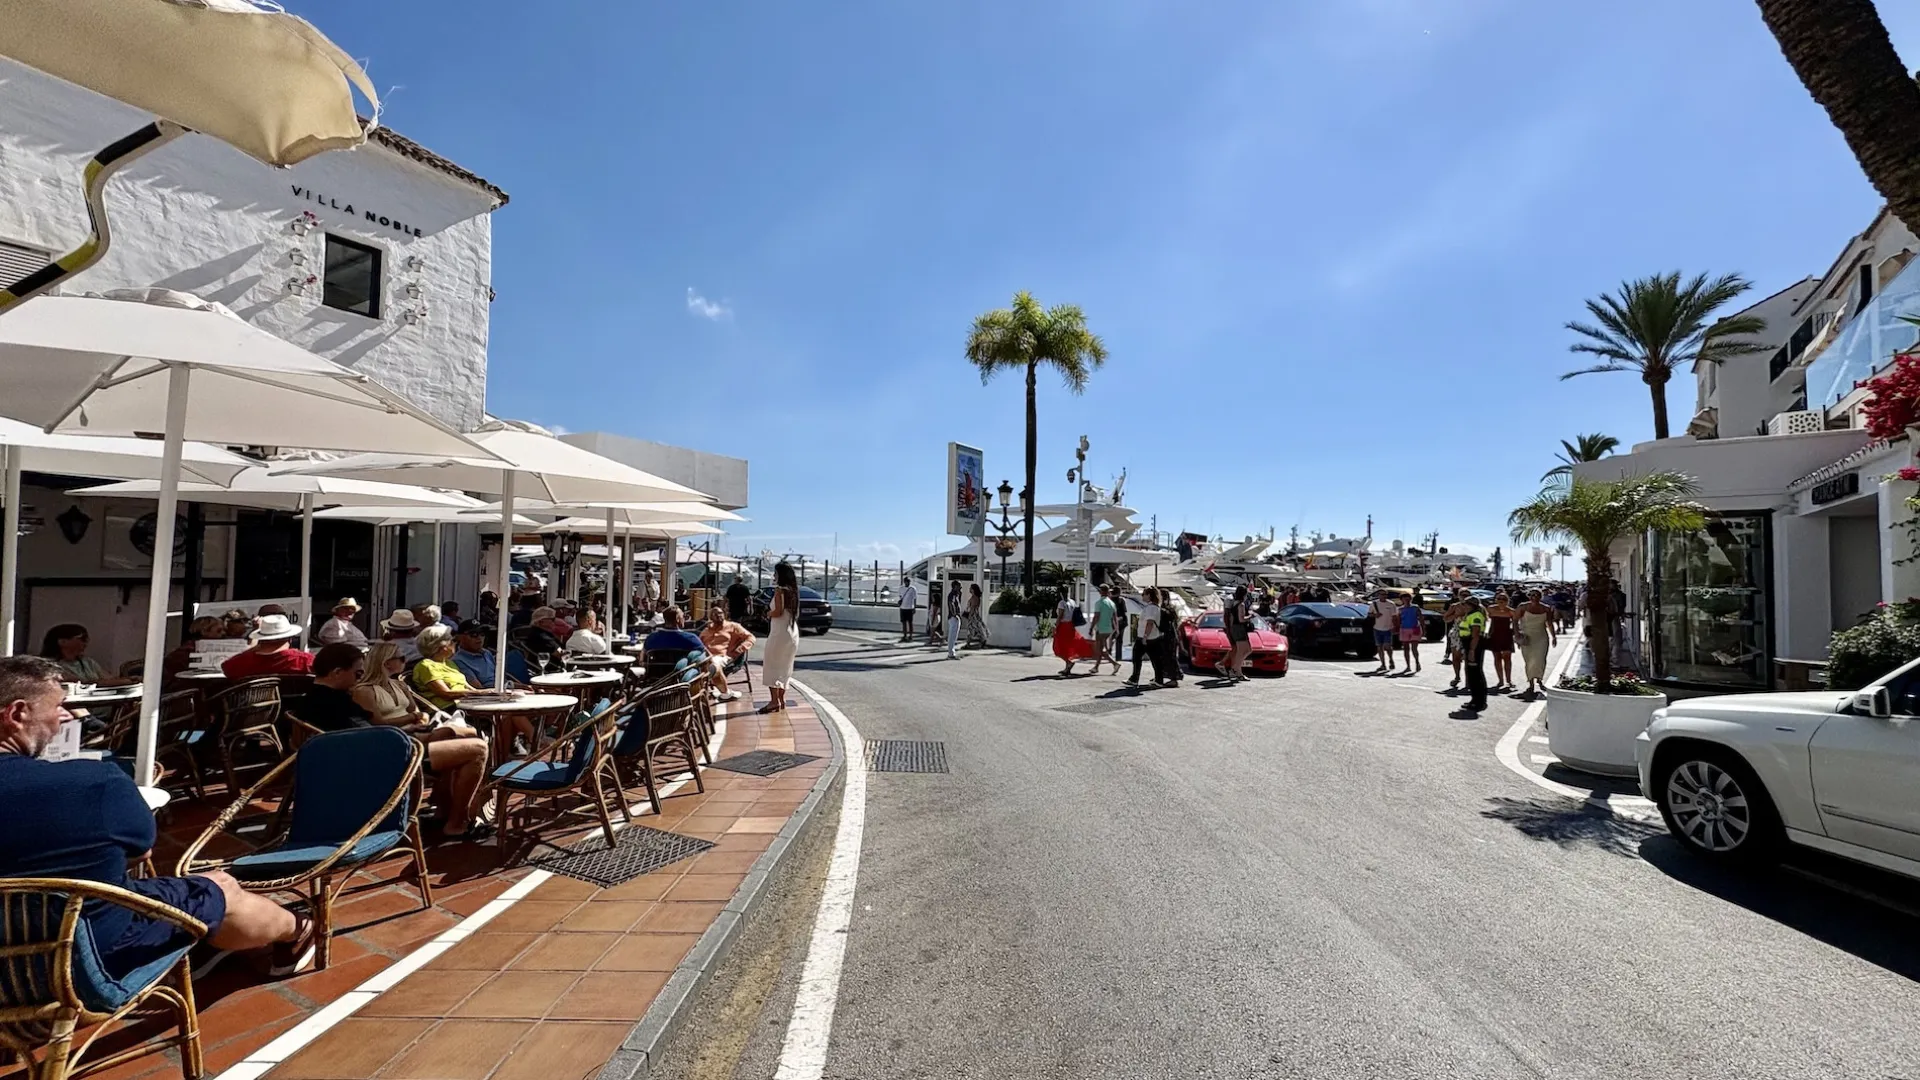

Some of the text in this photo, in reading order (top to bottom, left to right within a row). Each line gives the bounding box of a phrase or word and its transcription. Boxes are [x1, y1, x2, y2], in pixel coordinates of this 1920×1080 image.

[291, 185, 422, 238] VILLA NOBLE
[286, 610, 298, 624] ub
